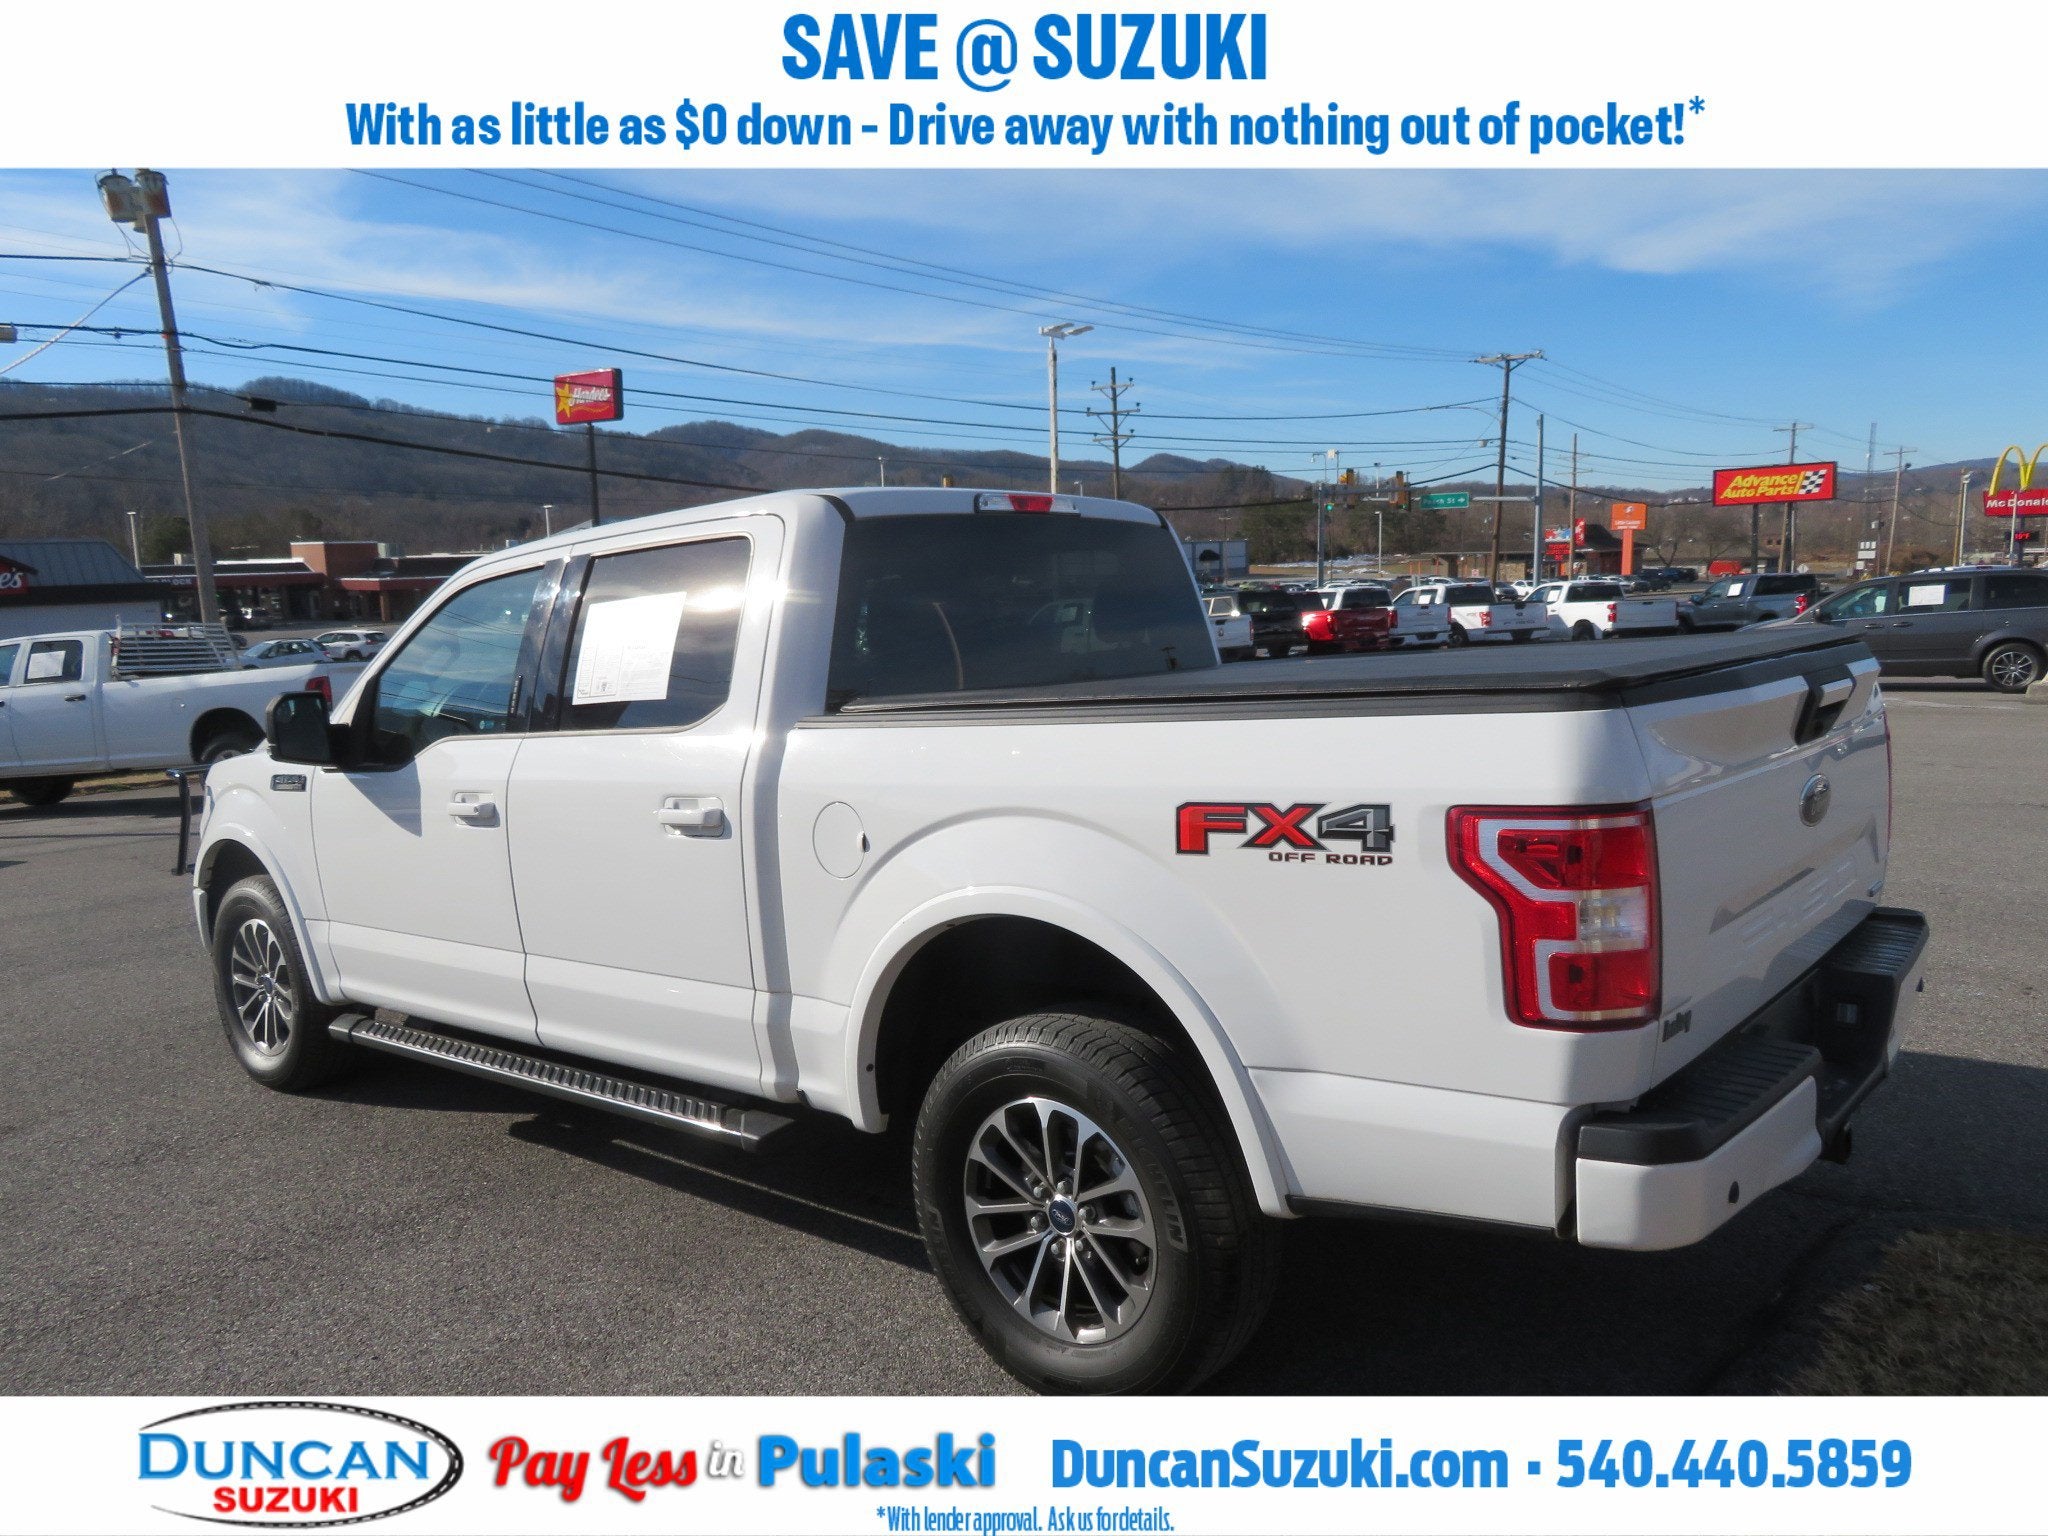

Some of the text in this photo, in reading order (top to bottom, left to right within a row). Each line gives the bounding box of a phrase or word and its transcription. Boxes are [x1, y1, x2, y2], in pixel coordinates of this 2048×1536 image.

[1727, 474, 1799, 489] Advance
[1720, 485, 1795, 498] Auto Parts
[1176, 802, 1394, 854] FX4
[1268, 851, 1393, 866] OFF ROAD
